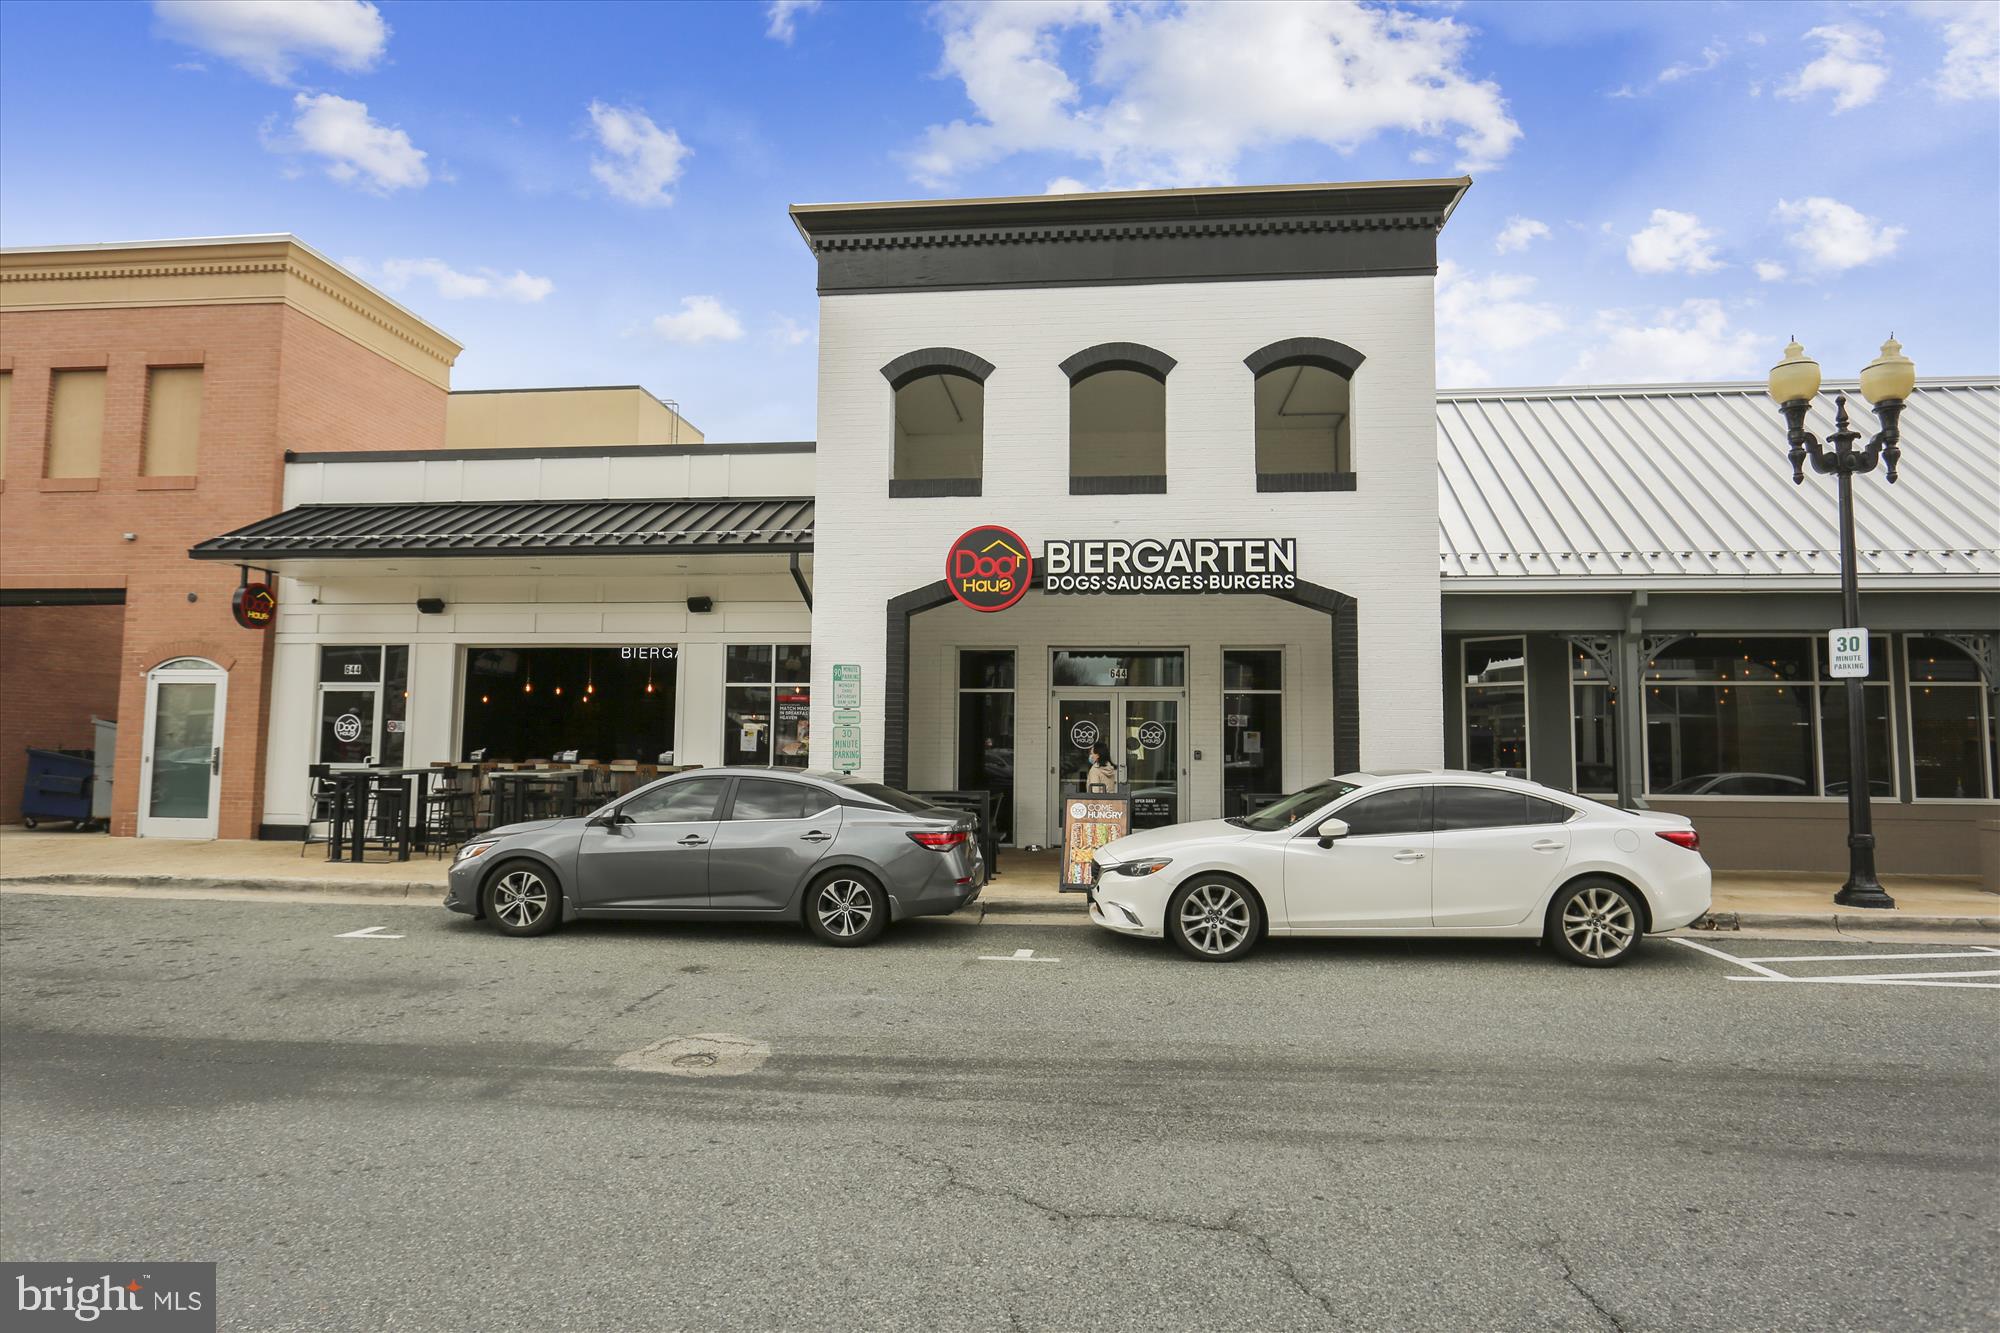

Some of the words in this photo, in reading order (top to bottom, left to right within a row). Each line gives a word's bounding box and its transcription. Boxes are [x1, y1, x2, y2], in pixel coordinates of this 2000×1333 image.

[1047, 540, 1294, 574] BIERGARTEN
[956, 550, 1017, 592] Dog
[1837, 636, 1860, 652] 30
[344, 664, 361, 674] 644
[1110, 668, 1127, 678] 644
[338, 721, 358, 733] Dog
[842, 729, 852, 738] 30
[1074, 728, 1095, 740] Dog
[1140, 728, 1162, 740] Dog
[834, 740, 859, 748] MINUTE
[834, 750, 860, 759] PARKING
[1088, 811, 1123, 819] HUNGRY
